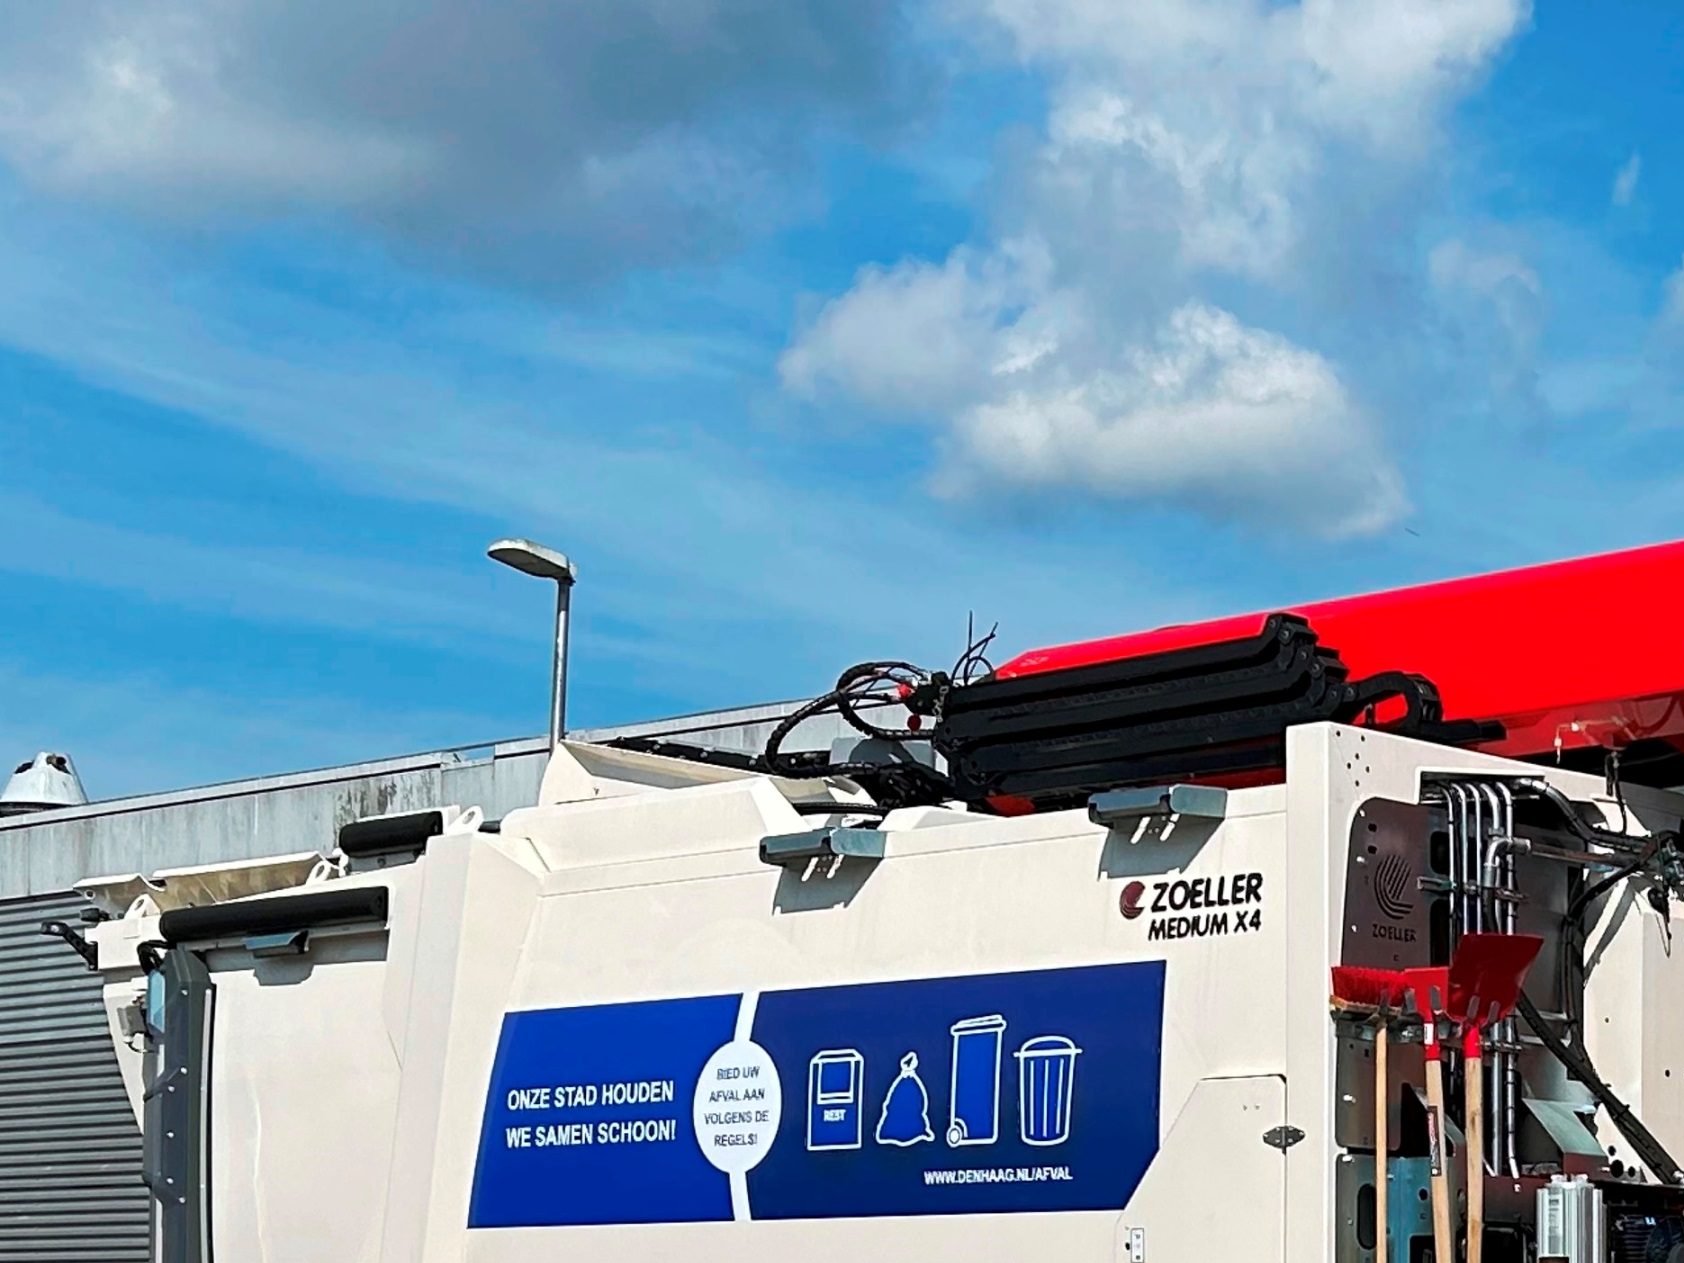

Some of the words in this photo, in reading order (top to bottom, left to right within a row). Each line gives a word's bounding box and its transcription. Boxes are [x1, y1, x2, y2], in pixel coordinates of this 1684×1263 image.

[1150, 872, 1263, 913] ZOELLER
[1147, 911, 1229, 942] MEDIUM
[1233, 908, 1262, 934] X4
[1372, 923, 1418, 943] ZOELLER
[742, 1065, 761, 1079] UW
[506, 1087, 551, 1111] ONZE
[554, 1085, 598, 1108] STAD
[601, 1080, 674, 1106] HOUDEN
[708, 1088, 740, 1103] AFVAL
[743, 1087, 765, 1101] AAN
[703, 1111, 752, 1125] VOLGENS
[755, 1109, 770, 1123] DE
[505, 1126, 532, 1149] WE
[534, 1123, 594, 1147] SAMEN
[597, 1119, 677, 1144] SCHOON!
[923, 1165, 1074, 1186] WWW.DENHAAG.NL/AFVAL
